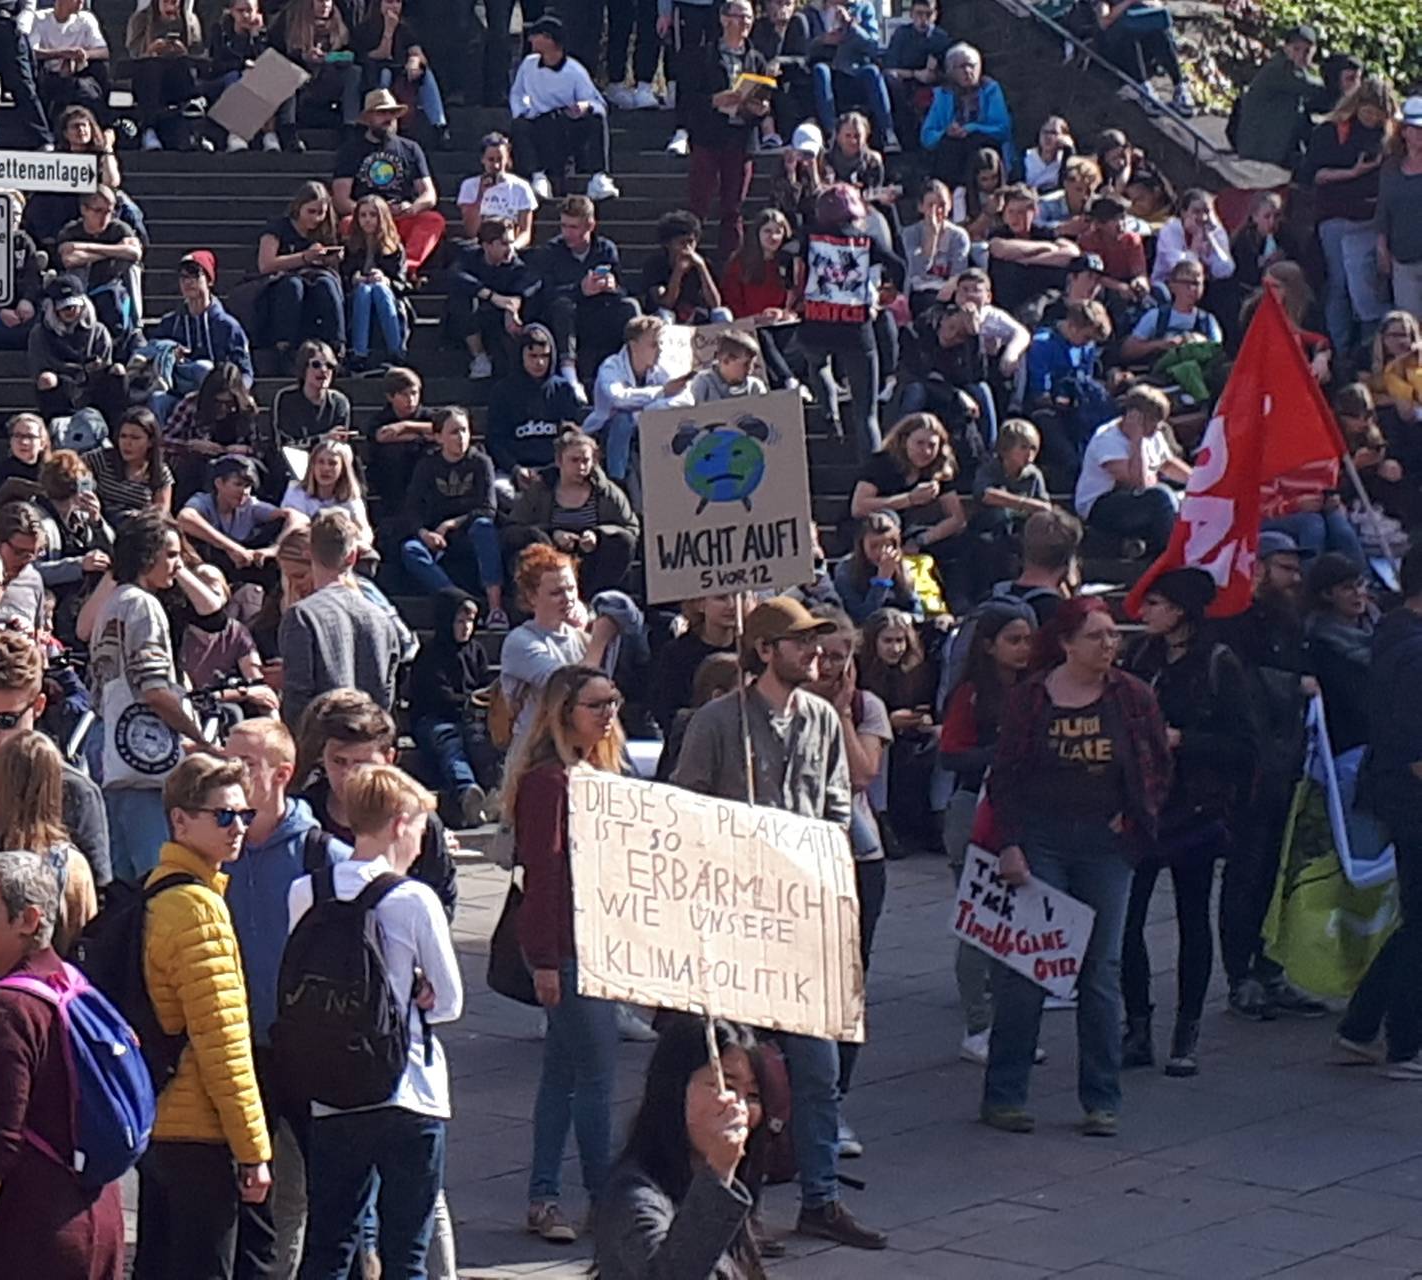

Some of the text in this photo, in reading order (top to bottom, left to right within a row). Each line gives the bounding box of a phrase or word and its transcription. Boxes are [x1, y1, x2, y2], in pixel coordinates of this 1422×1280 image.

[656, 517, 800, 570] WACHT AUF!
[700, 564, 773, 589] 5 VOR 12
[584, 778, 828, 859] DIESES PLAKAT
[594, 817, 682, 851] IST SO
[626, 849, 827, 920] ERBÄRMLICH
[597, 887, 795, 943] WIE UNSERE
[604, 934, 815, 1005] KLIMAPOLITIK
[1033, 957, 1079, 981] OVER
